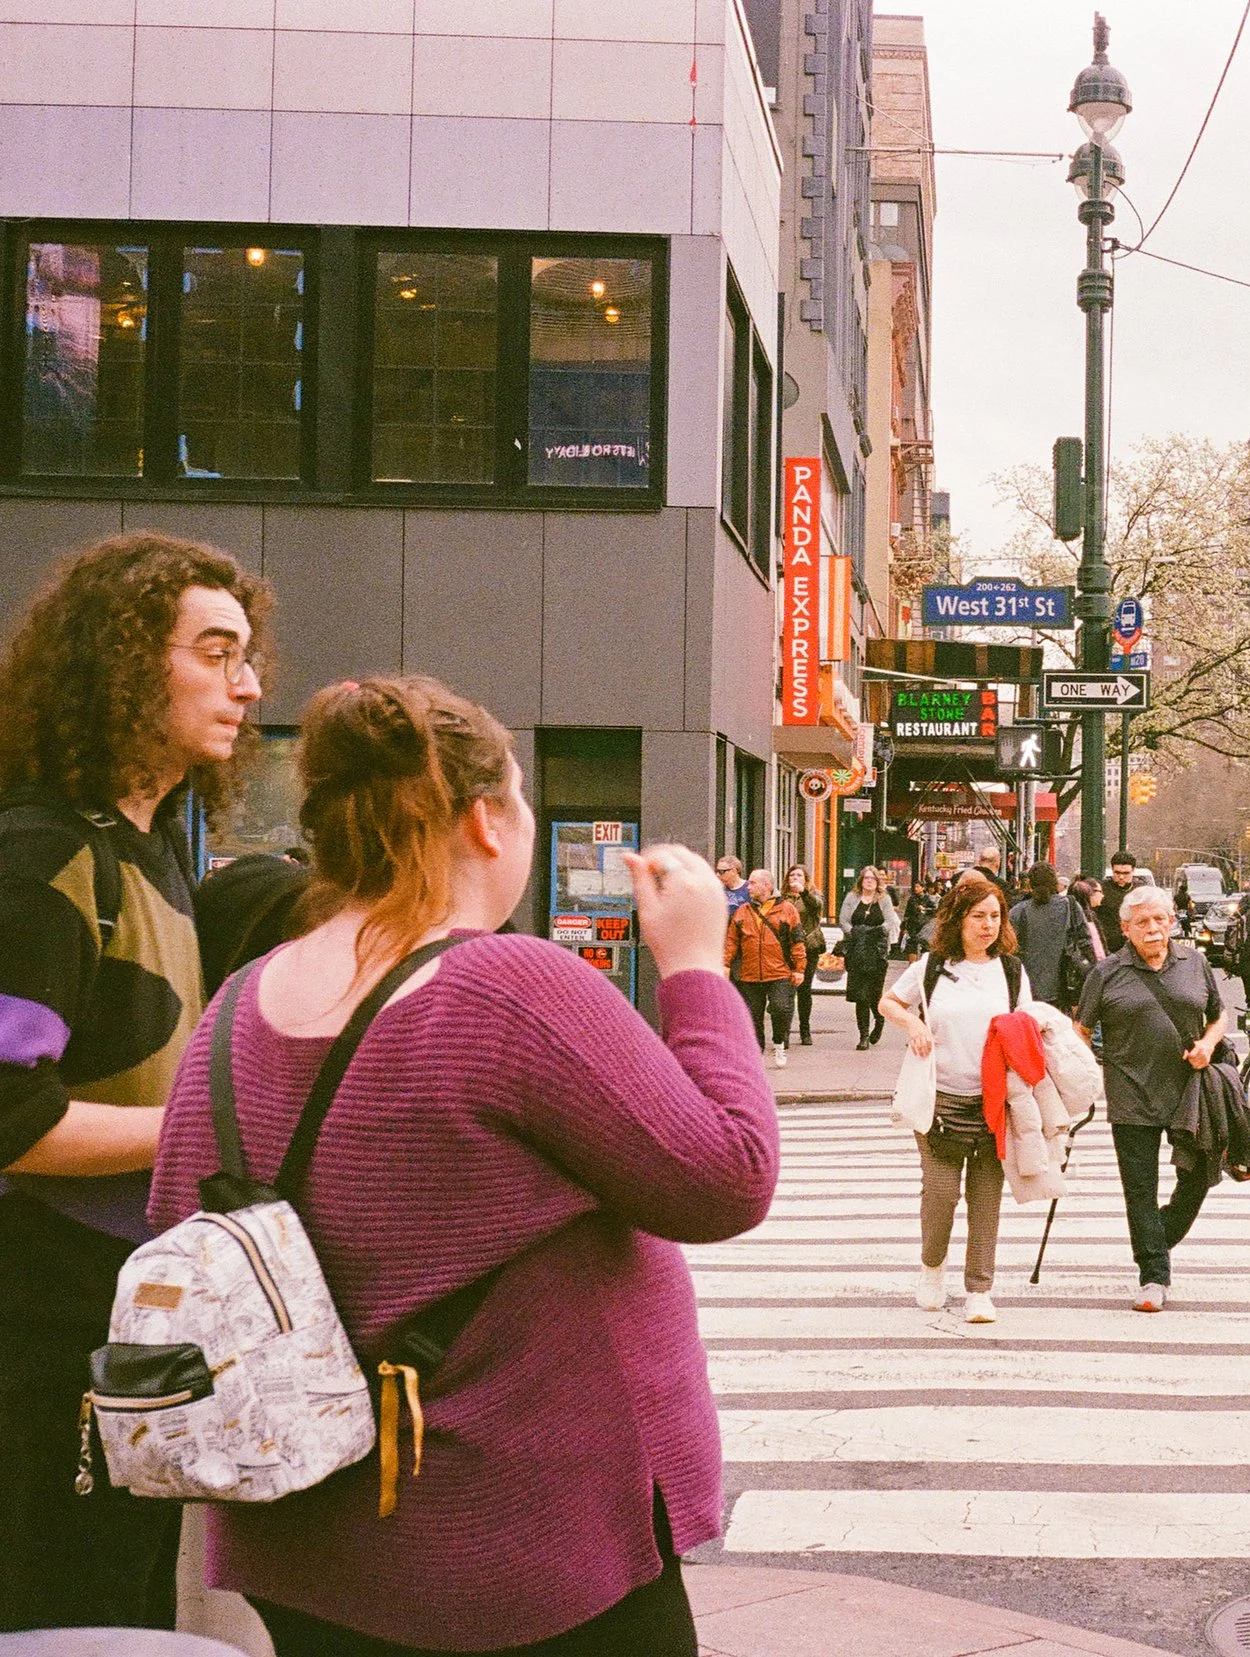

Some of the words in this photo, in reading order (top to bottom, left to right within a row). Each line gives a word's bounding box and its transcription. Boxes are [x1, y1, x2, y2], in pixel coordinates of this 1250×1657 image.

[791, 466, 812, 567] PANDA
[976, 582, 993, 592] 200
[1000, 583, 1017, 592] 262
[936, 595, 989, 616] West
[994, 595, 1030, 616] 31st
[1035, 597, 1055, 617] St
[791, 576, 811, 718] EXPRESS
[1060, 683, 1087, 697] ONE
[1100, 683, 1132, 697] WAY
[897, 692, 972, 707] BLARNEY
[920, 707, 965, 721] STONE
[980, 691, 996, 736] BAR
[896, 722, 978, 736] RESTAURANT
[918, 803, 953, 816] Kentucky
[953, 803, 973, 815] Fried
[595, 824, 620, 841] EXIT
[556, 918, 589, 926] DANGER
[597, 918, 629, 929] KEEP
[600, 929, 625, 940] OUT
